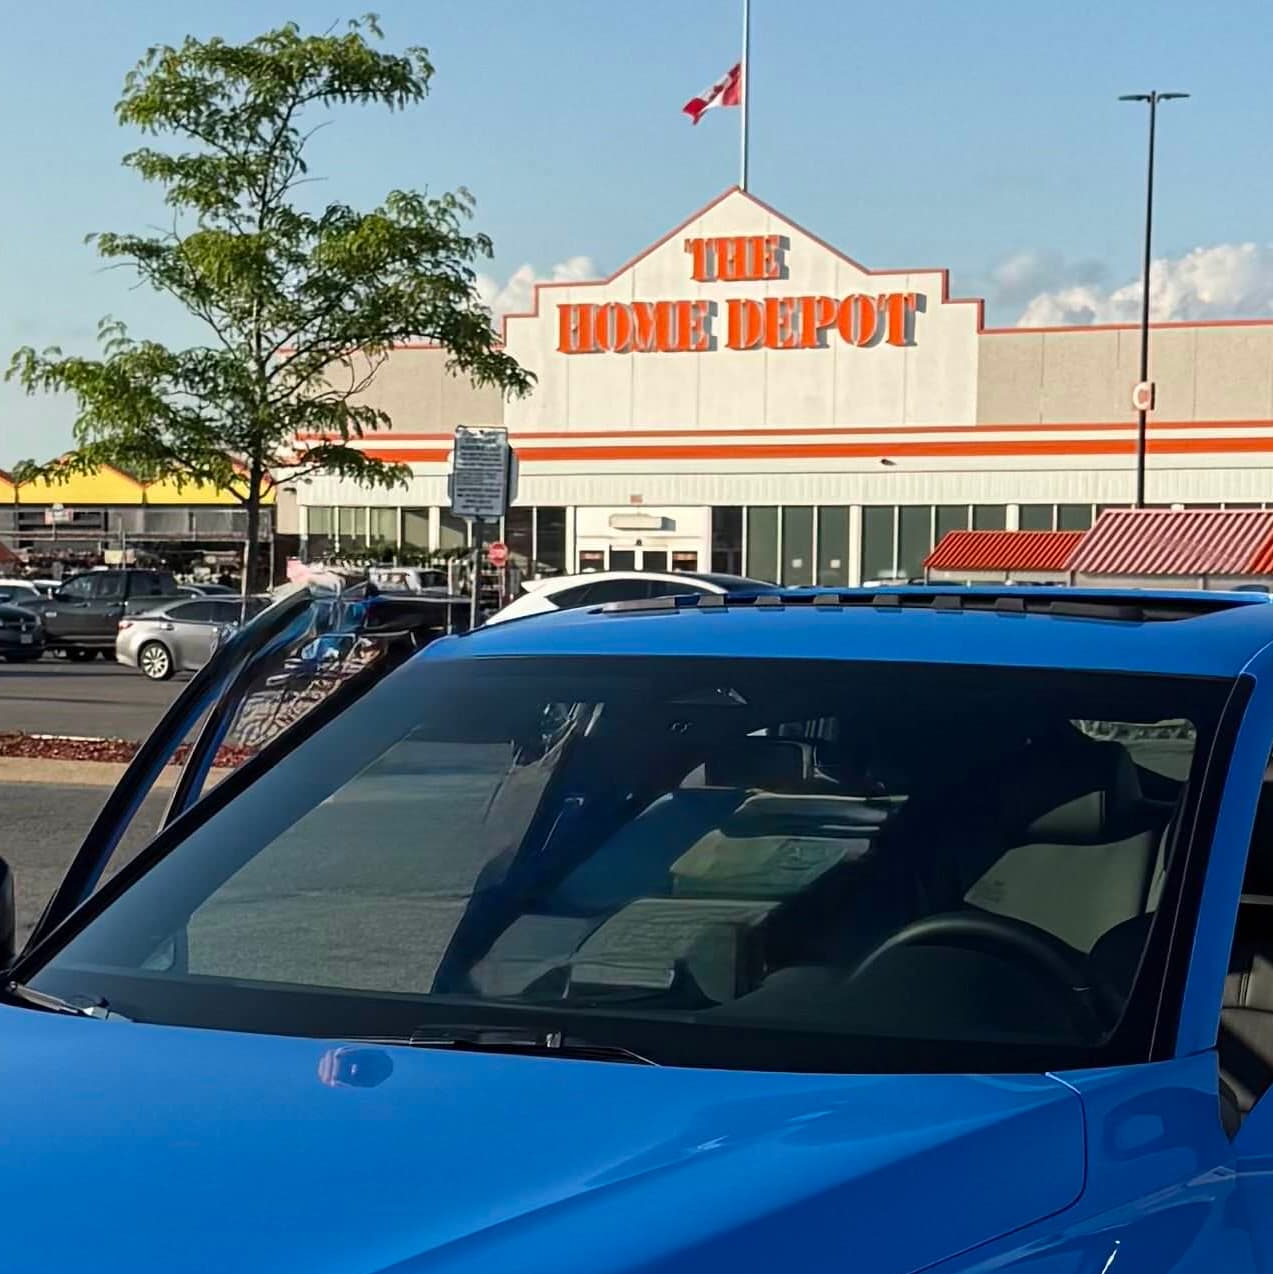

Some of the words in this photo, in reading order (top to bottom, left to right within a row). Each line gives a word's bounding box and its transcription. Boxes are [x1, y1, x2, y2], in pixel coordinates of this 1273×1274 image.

[684, 235, 784, 282] THE
[556, 300, 712, 354] HOME
[725, 292, 922, 350] DEPOT
